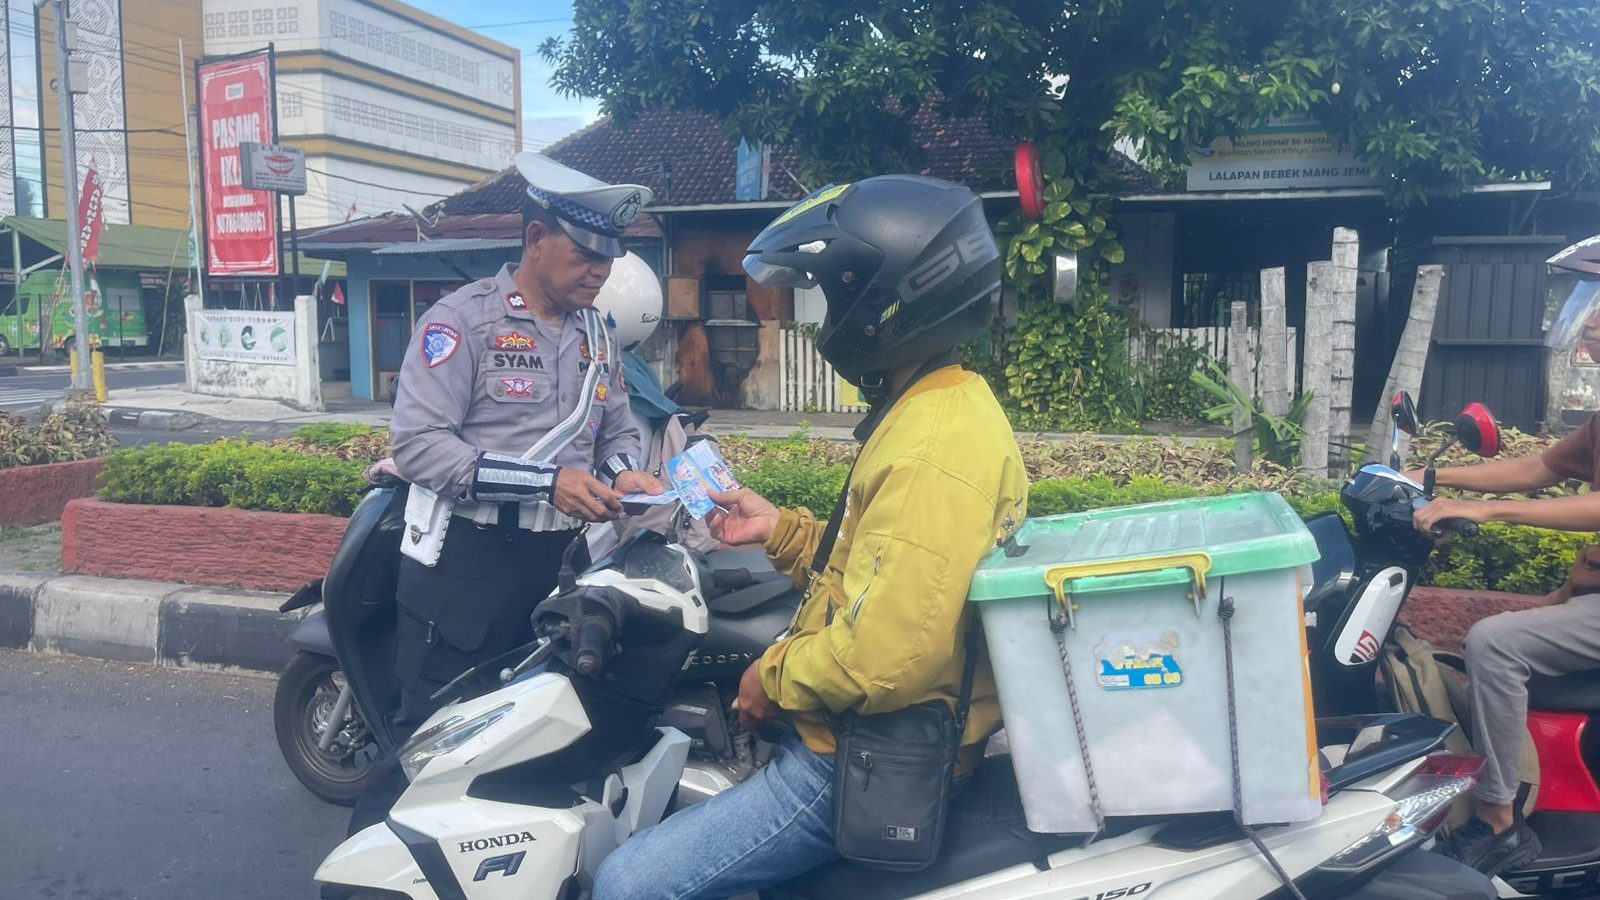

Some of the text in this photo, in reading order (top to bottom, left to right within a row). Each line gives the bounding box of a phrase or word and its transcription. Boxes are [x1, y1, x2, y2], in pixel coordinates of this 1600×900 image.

[212, 112, 260, 150] PASANG
[1208, 170, 1260, 181] LALAPAN
[1262, 169, 1300, 180] BEBEK
[1302, 168, 1340, 179] MANG
[493, 353, 544, 369] SYAM
[459, 831, 536, 853] HONDA
